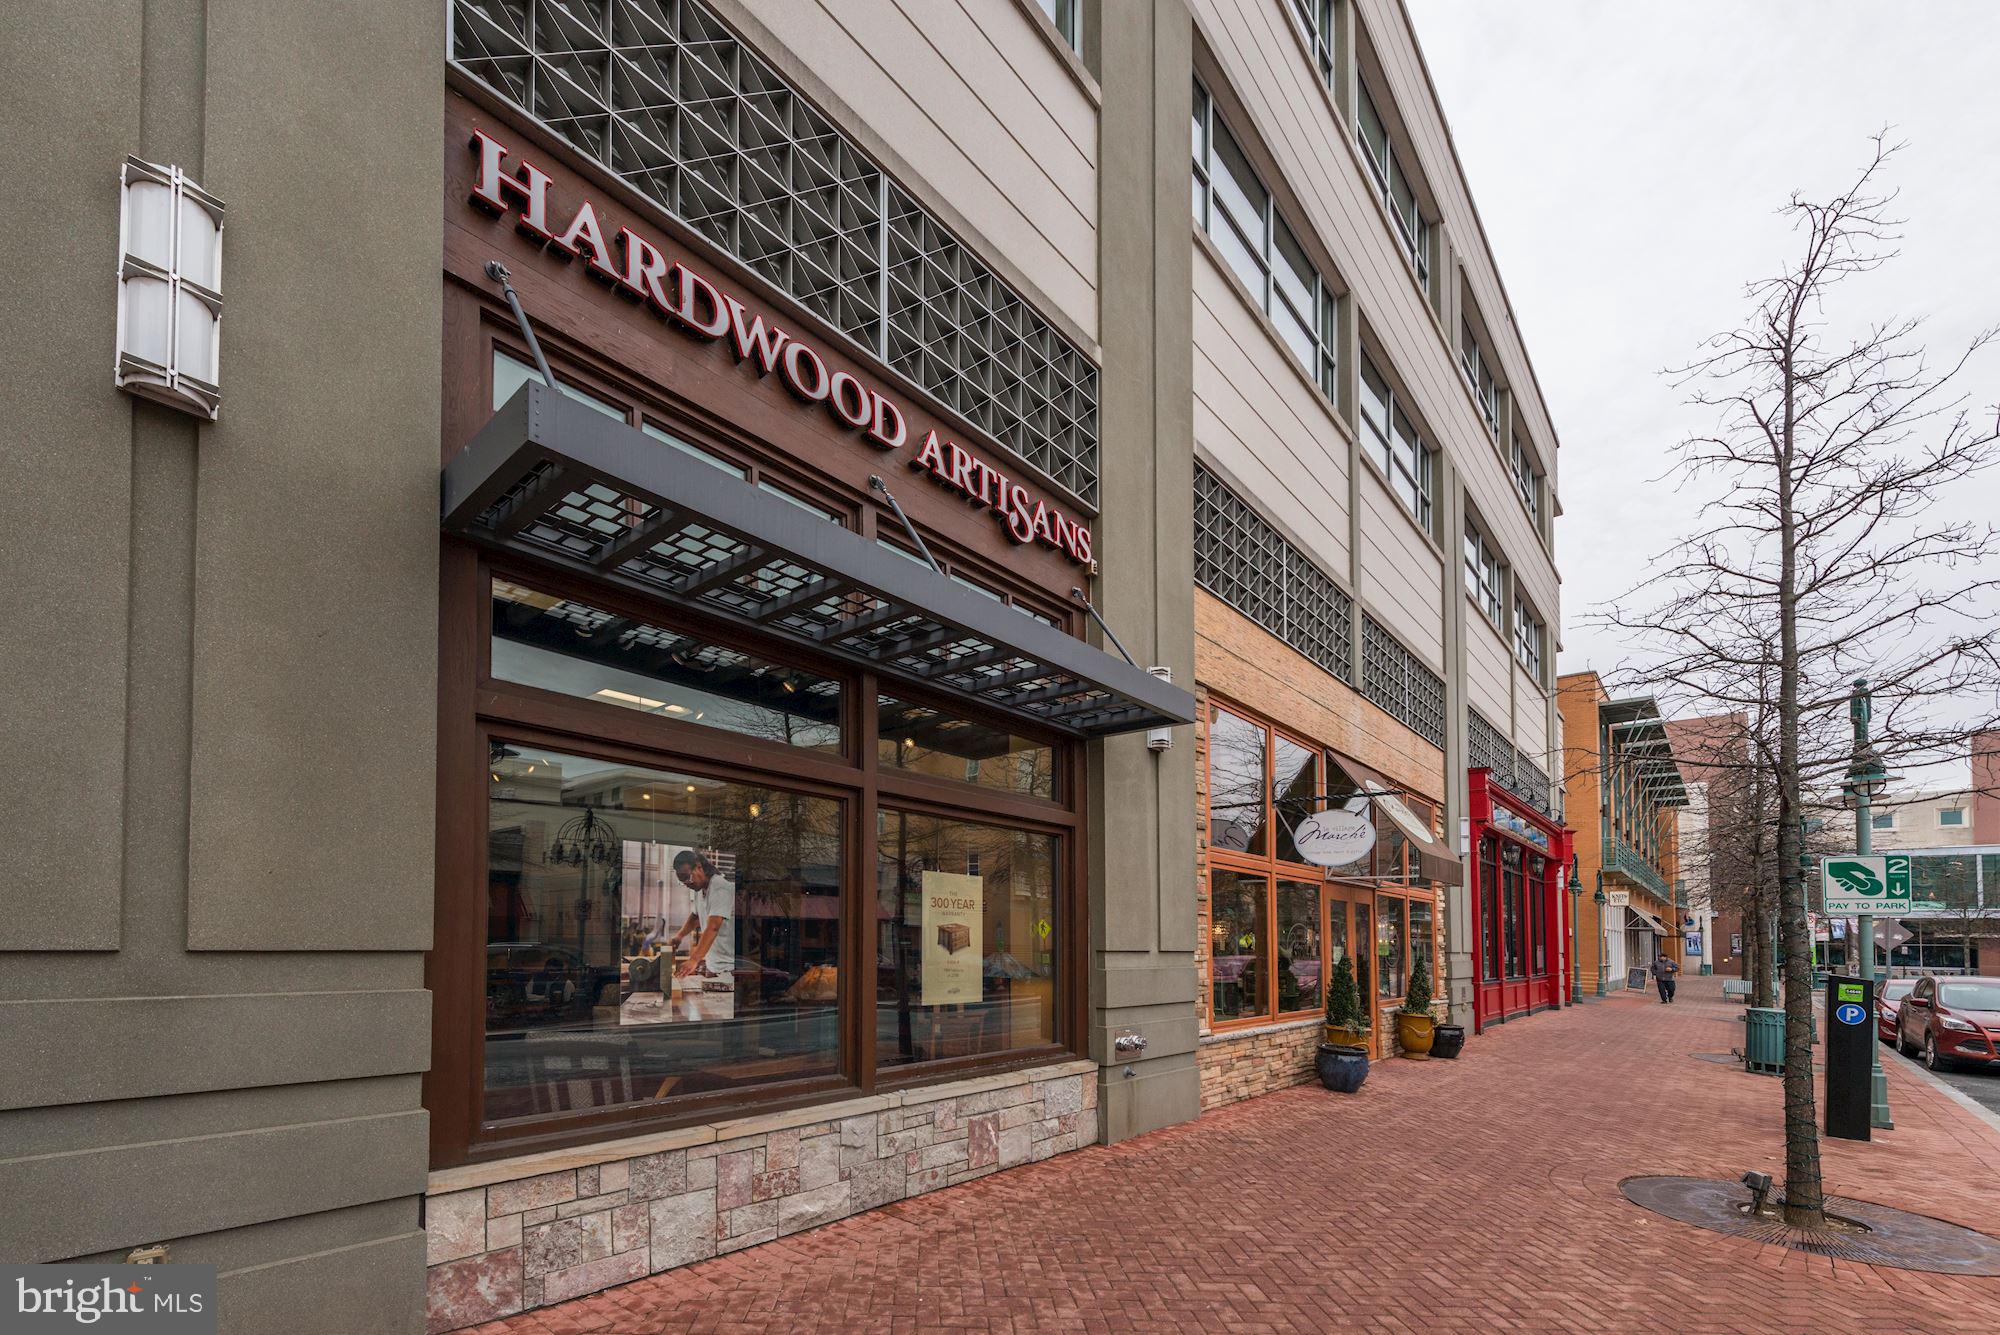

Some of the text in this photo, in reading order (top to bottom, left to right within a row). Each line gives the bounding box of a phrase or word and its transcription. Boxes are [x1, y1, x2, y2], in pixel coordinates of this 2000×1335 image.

[471, 128, 1092, 564] HARDWOOD ARTISANS
[1888, 858, 1908, 874] 2
[930, 897, 975, 910] 300 YEAR
[1828, 902, 1906, 910] PAY TO PARK
[1845, 1007, 1859, 1022] P
